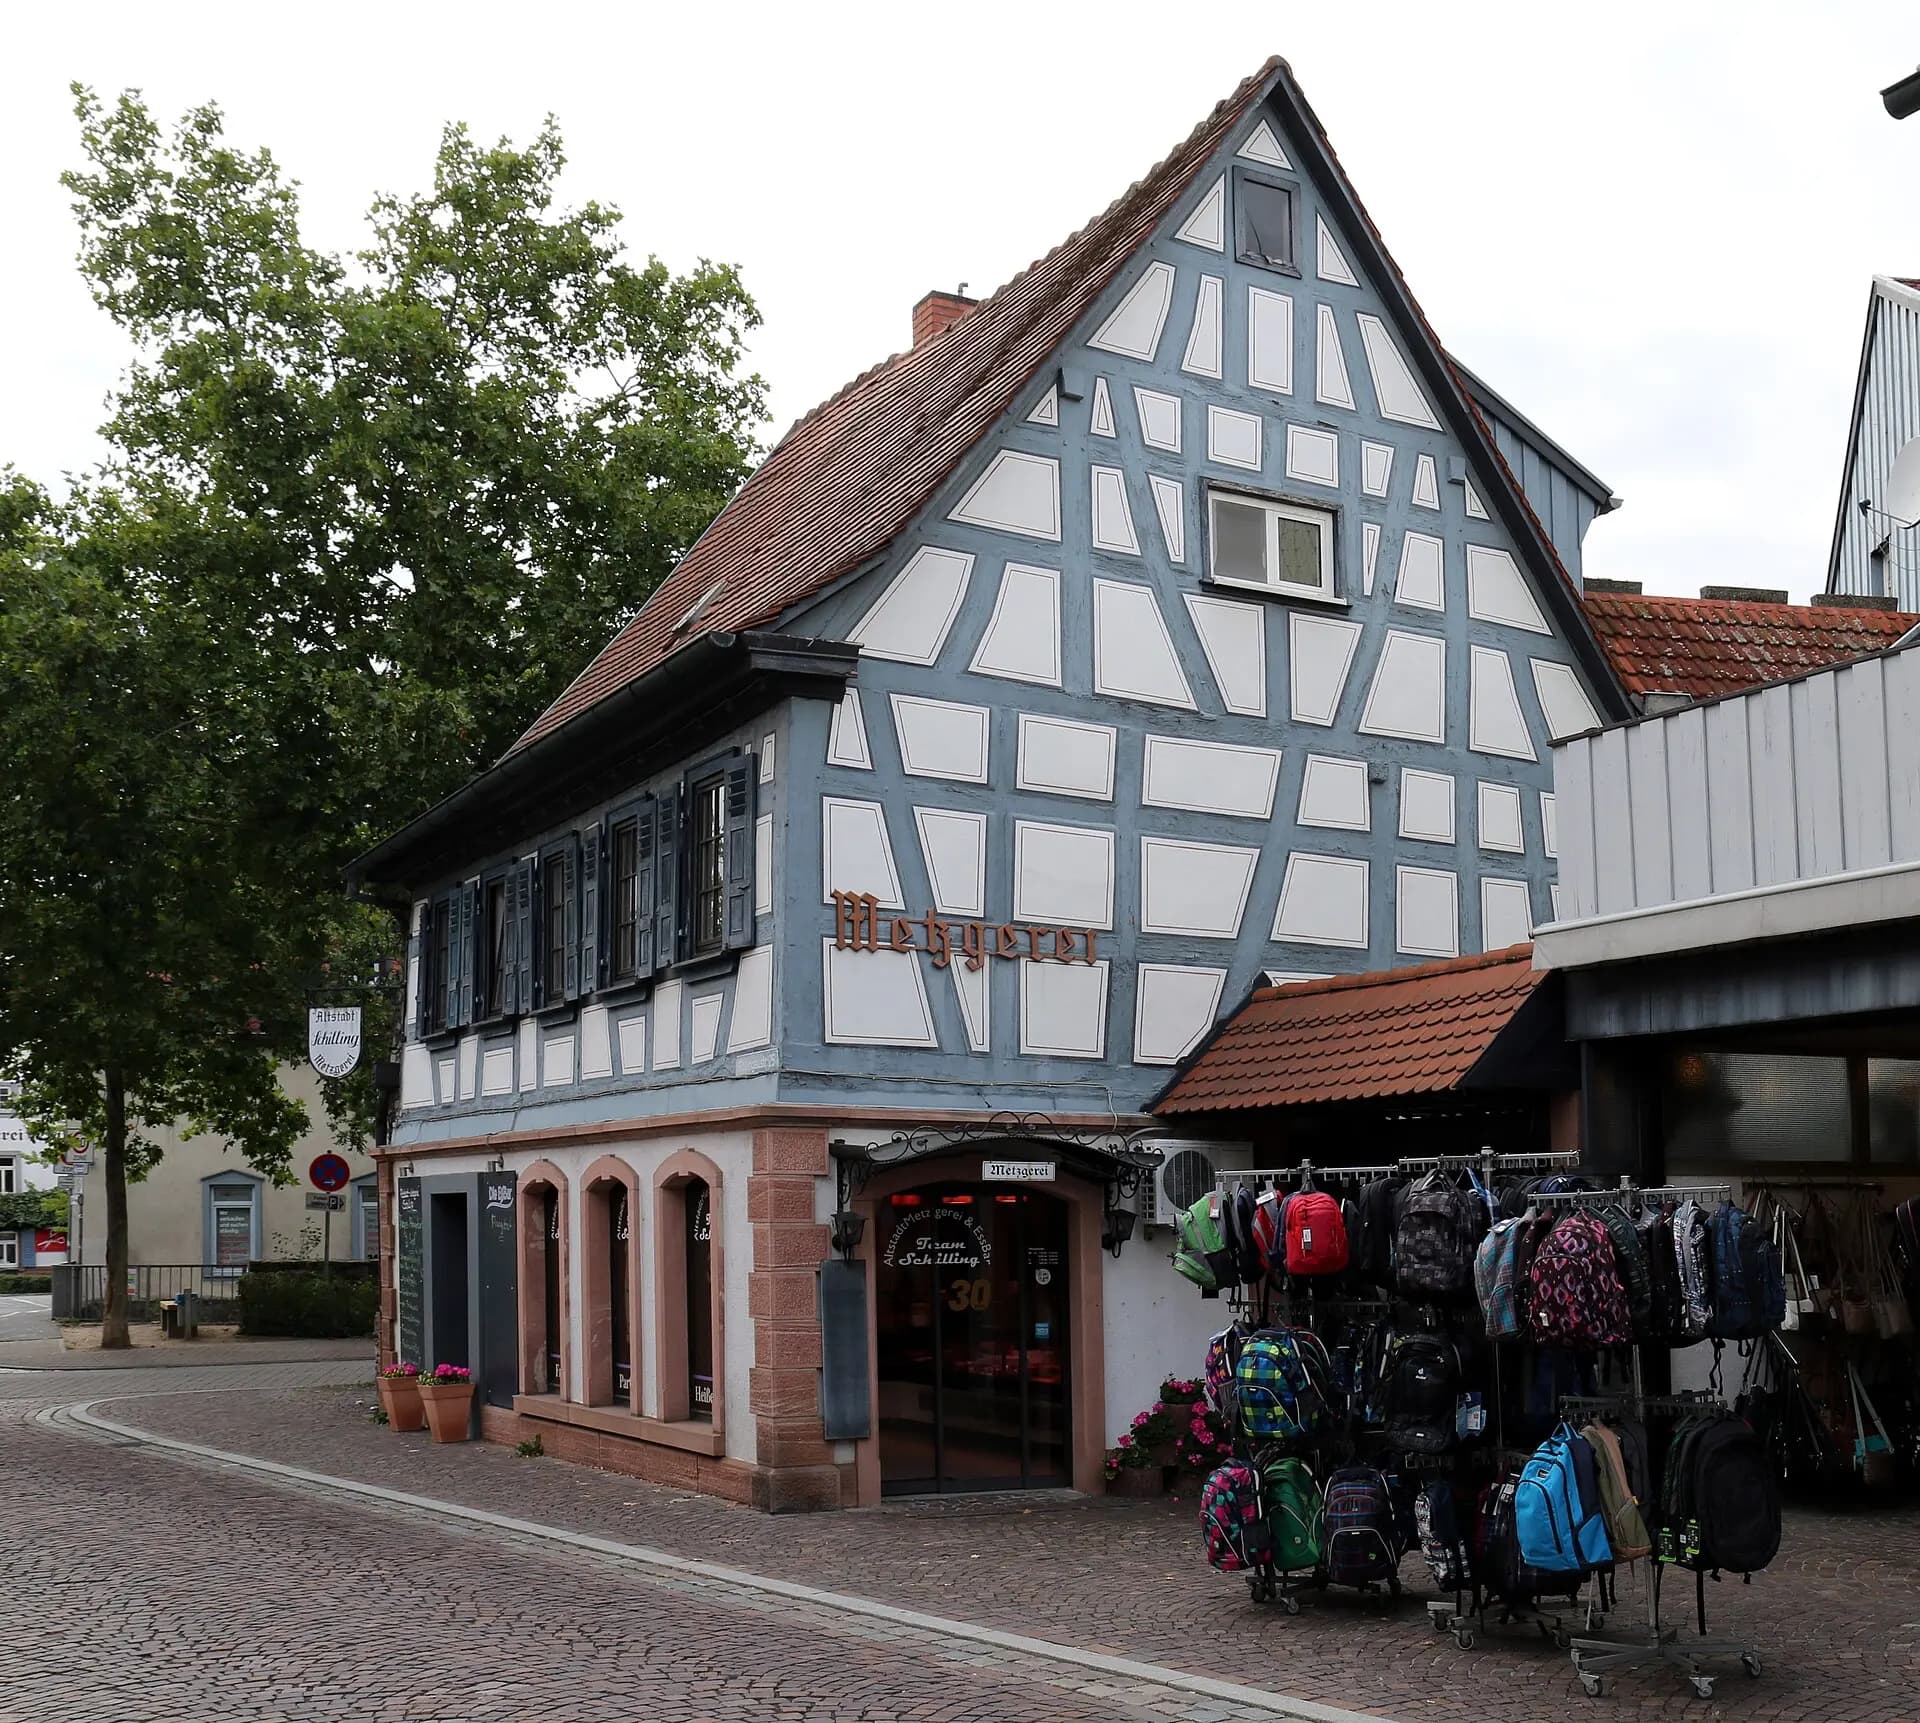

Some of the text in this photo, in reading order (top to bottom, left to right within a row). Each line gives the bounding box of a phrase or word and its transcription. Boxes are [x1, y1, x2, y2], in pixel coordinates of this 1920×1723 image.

[831, 889, 1096, 971] Metzgerei
[316, 1011, 355, 1023] Altstadt
[311, 1031, 359, 1048] Schilling
[990, 1164, 1049, 1178] Metzgerei
[972, 1225, 992, 1265] EssBar
[899, 1252, 981, 1268] Schilling
[949, 1279, 992, 1312] 30
